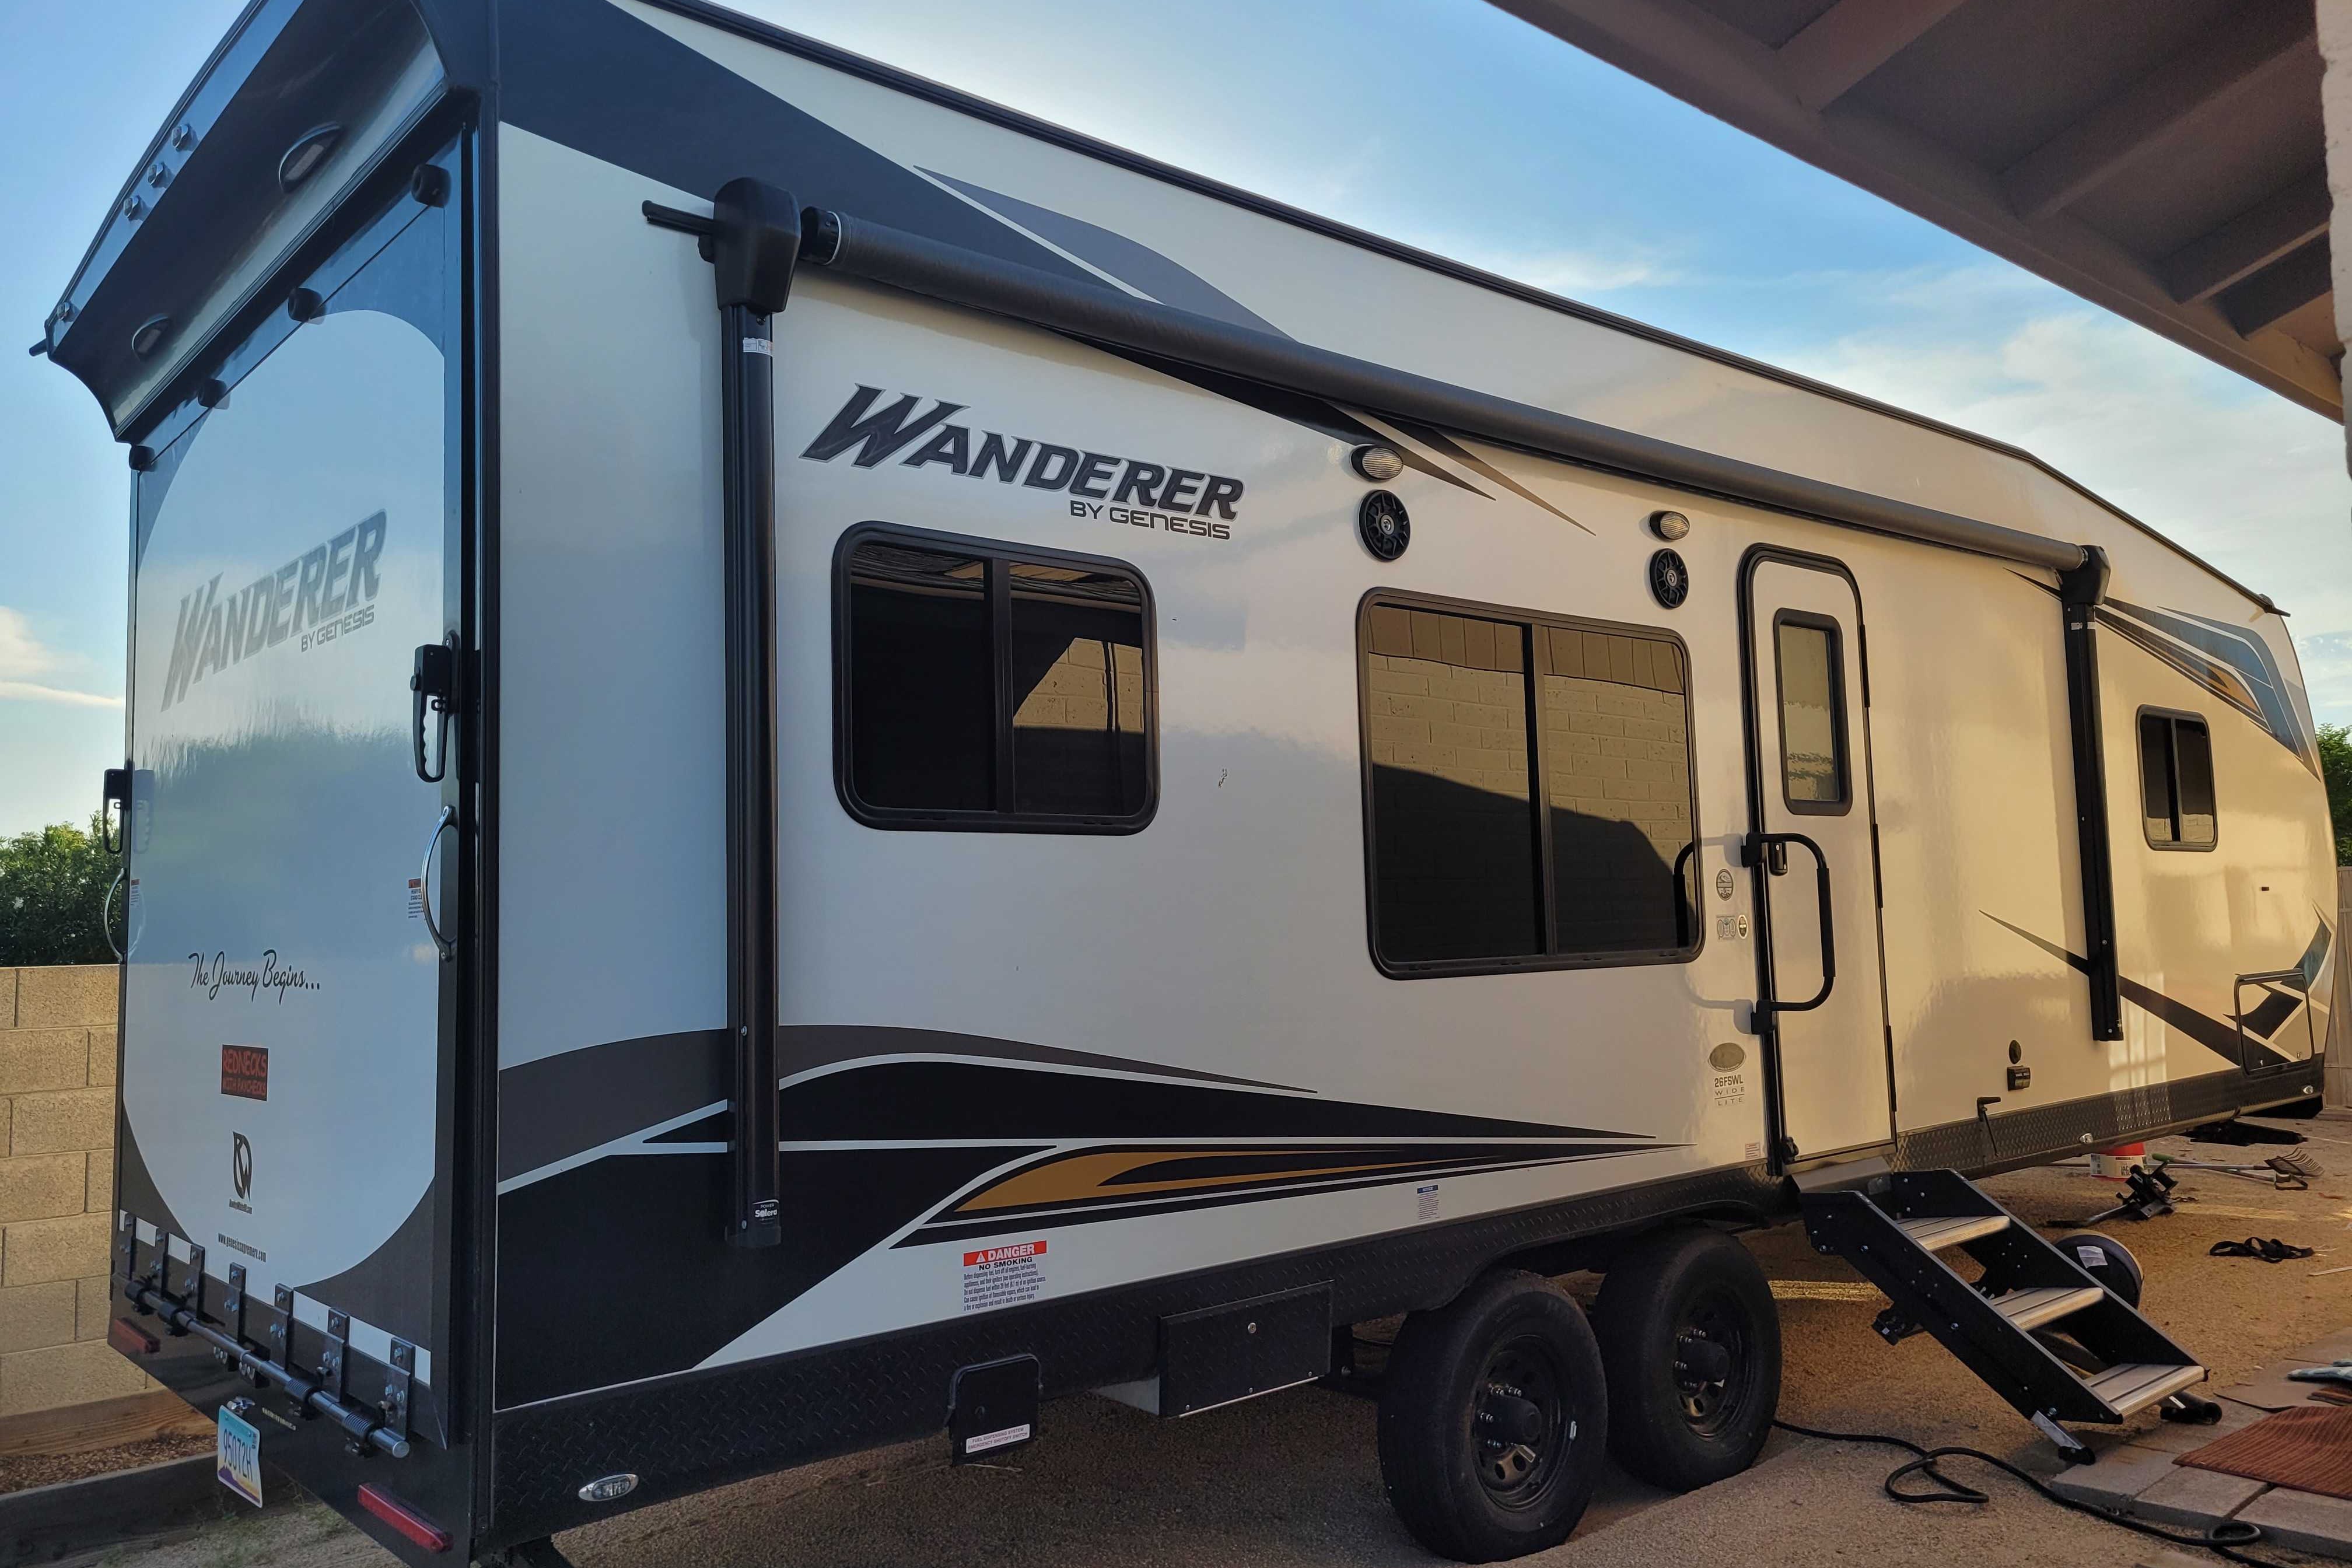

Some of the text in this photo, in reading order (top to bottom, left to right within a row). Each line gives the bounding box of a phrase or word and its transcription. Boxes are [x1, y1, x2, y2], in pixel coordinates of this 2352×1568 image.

[799, 383, 1245, 520] WANDERER
[1071, 500, 1231, 540] BY GENESIS
[160, 508, 387, 712] WANDERER
[301, 604, 375, 653] BY GENESIS
[188, 952, 210, 989] The
[209, 951, 260, 1003] Journey
[223, 1048, 267, 1077] REDNECKS
[1714, 1074, 1744, 1088] 26FSWL
[1715, 1086, 1745, 1096] WIDE
[1718, 1097, 1743, 1107] LITE
[755, 1208, 778, 1217] Solera
[988, 1243, 1035, 1261] DANGER
[994, 1256, 1032, 1268] SMOKING
